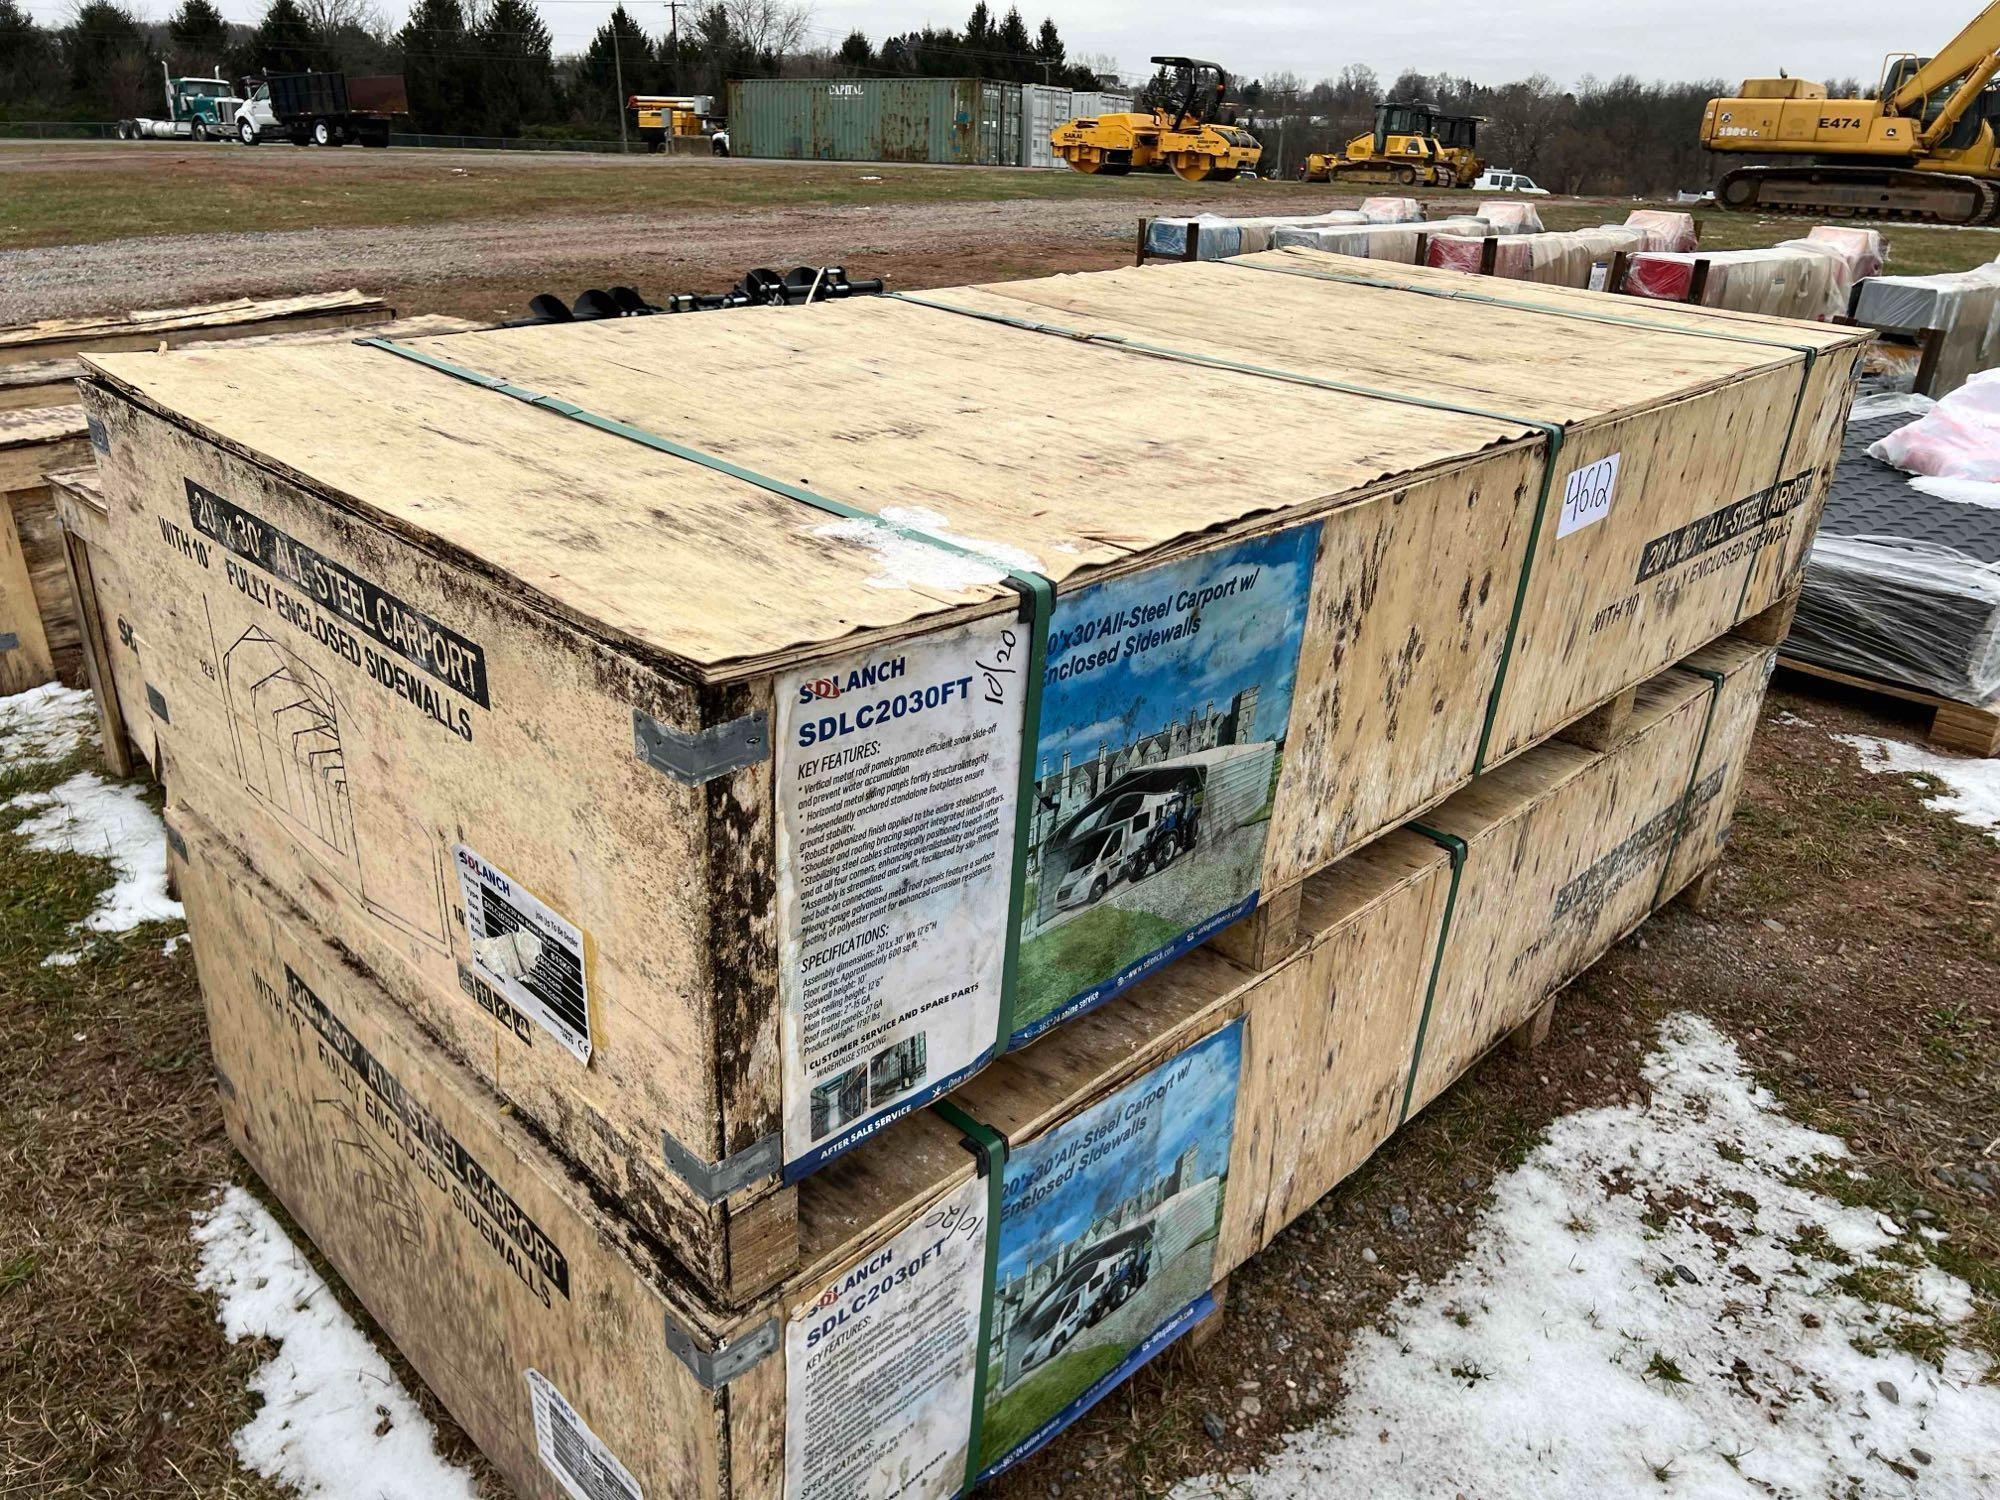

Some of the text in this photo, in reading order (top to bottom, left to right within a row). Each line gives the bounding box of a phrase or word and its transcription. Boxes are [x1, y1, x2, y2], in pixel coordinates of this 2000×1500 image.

[828, 85, 864, 94] CAPITAL
[1819, 118, 1860, 128] E474
[1566, 462, 1612, 522] 4612
[1689, 541, 1744, 584] ENCLOSED
[158, 515, 472, 742] WITH 10' FULLY ENCLOSED SIDEWALLS
[1047, 567, 1261, 656] 0'x30'All-Steel Carport w/
[376, 598, 476, 693] CARPORT
[1122, 617, 1202, 658] Sidewalls
[976, 630, 1016, 705] 10/20
[798, 676, 973, 748] SDLC2030FT
[797, 738, 880, 781] KEY FEATURES:
[804, 723, 996, 794] Vertical roof panels promote efficient snow slide-off
[842, 764, 909, 793] water accumulation
[806, 767, 984, 836] Independently anchored standalone footplates ensure
[807, 770, 930, 821] Horizontal metal siding panels fortify
[800, 835, 823, 852] ground
[829, 807, 934, 852] galvanized finish applied to the
[837, 820, 929, 861] and roofing bracing support
[841, 834, 925, 871] steel cables strategically
[800, 850, 912, 900] and all four enhancing
[846, 865, 899, 893] streamlined and
[852, 870, 944, 915] galvanized roof panels
[801, 912, 814, 925] and
[828, 886, 930, 938] of polyester paint for enhanced
[801, 921, 889, 974] SPECIFICATIONS:
[802, 948, 874, 989] Assembly dimensions:
[803, 946, 901, 999] Floor area: Approximately 600
[803, 979, 855, 1011] Sidewall height:
[803, 994, 870, 1034] Main frame: GA
[803, 998, 882, 1045] Roof metal panels: 27 GA
[804, 985, 866, 1022] Peak ceiling height:
[1079, 991, 1099, 1008] service
[803, 1011, 880, 1056] Product weight: 1797 lbs
[809, 982, 978, 1070] CUSTOMER SERVICE AND SPARE PARTS
[856, 1034, 886, 1057] STOCKING
[1124, 1074, 1175, 1120] Carport
[1177, 1058, 1193, 1083] w/
[252, 968, 282, 1013] WITH
[365, 1091, 448, 1193] ENCLOSED
[452, 1185, 551, 1310] SIDEWALLS
[821, 1104, 912, 1160] AFTER SALE SERVICE
[1000, 1116, 1147, 1222] Enclosed Sidewalls
[466, 1162, 560, 1280] CARPORT
[806, 1238, 947, 1348] SDLC2030FT
